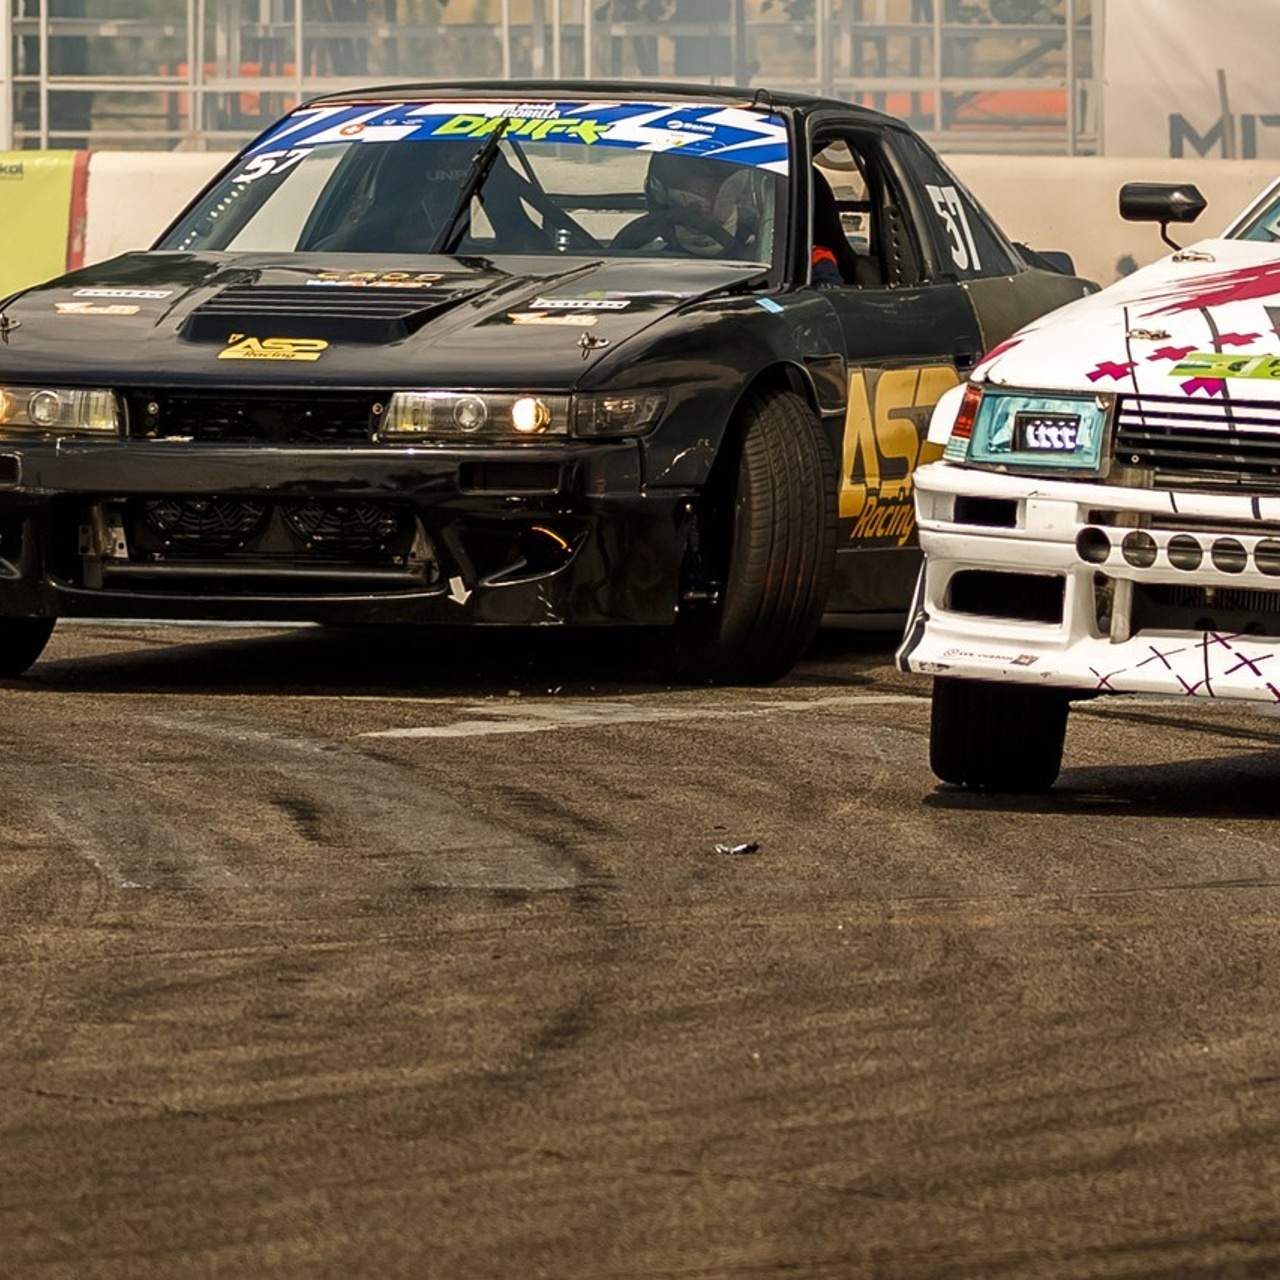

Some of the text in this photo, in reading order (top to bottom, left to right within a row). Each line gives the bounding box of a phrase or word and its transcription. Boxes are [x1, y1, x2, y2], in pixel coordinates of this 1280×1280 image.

[232, 147, 315, 183] 57
[925, 184, 982, 270] 57
[851, 493, 915, 547] Racing
